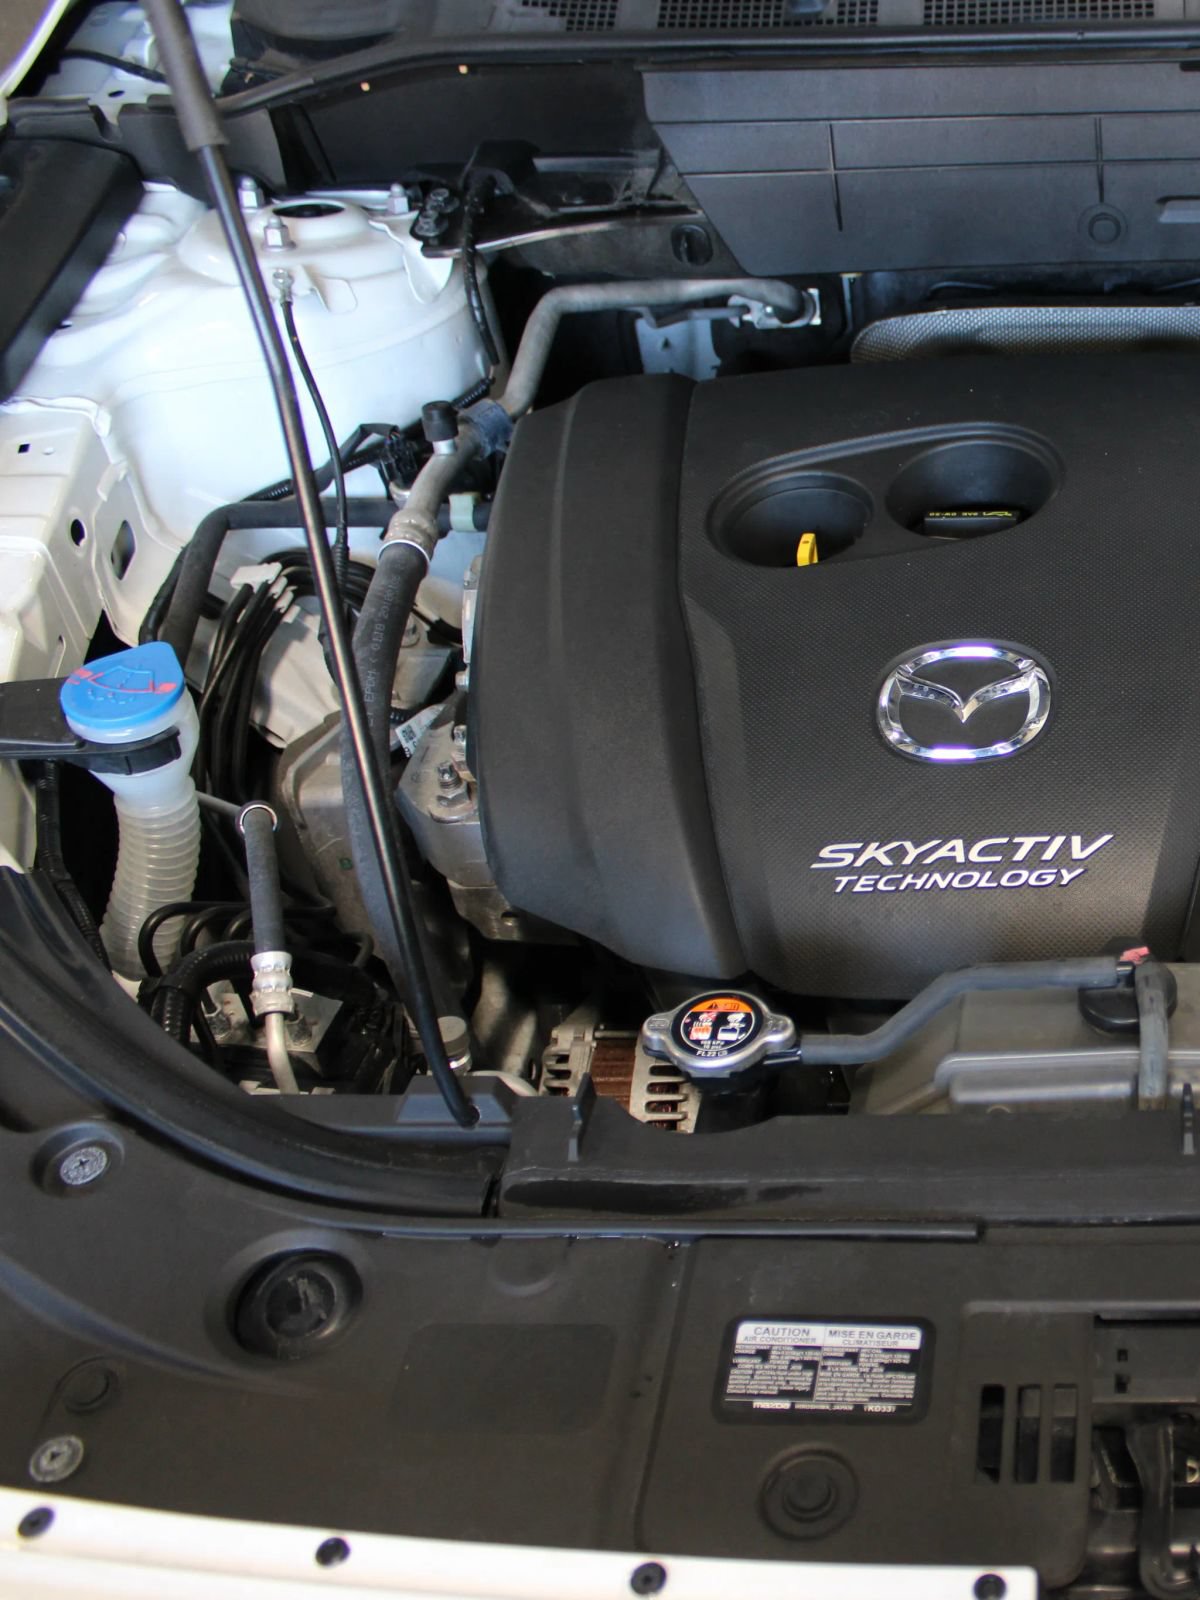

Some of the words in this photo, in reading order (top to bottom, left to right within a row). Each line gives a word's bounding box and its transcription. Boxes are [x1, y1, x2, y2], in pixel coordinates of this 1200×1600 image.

[809, 833, 1115, 869] SKYACTIV
[833, 867, 1087, 894] TECHNOLOGY
[753, 1326, 811, 1337] CAUTION
[828, 1329, 857, 1339] MISE
[858, 1330, 874, 1339] EN
[875, 1331, 917, 1341] GARDE
[752, 1401, 792, 1409] mazda
